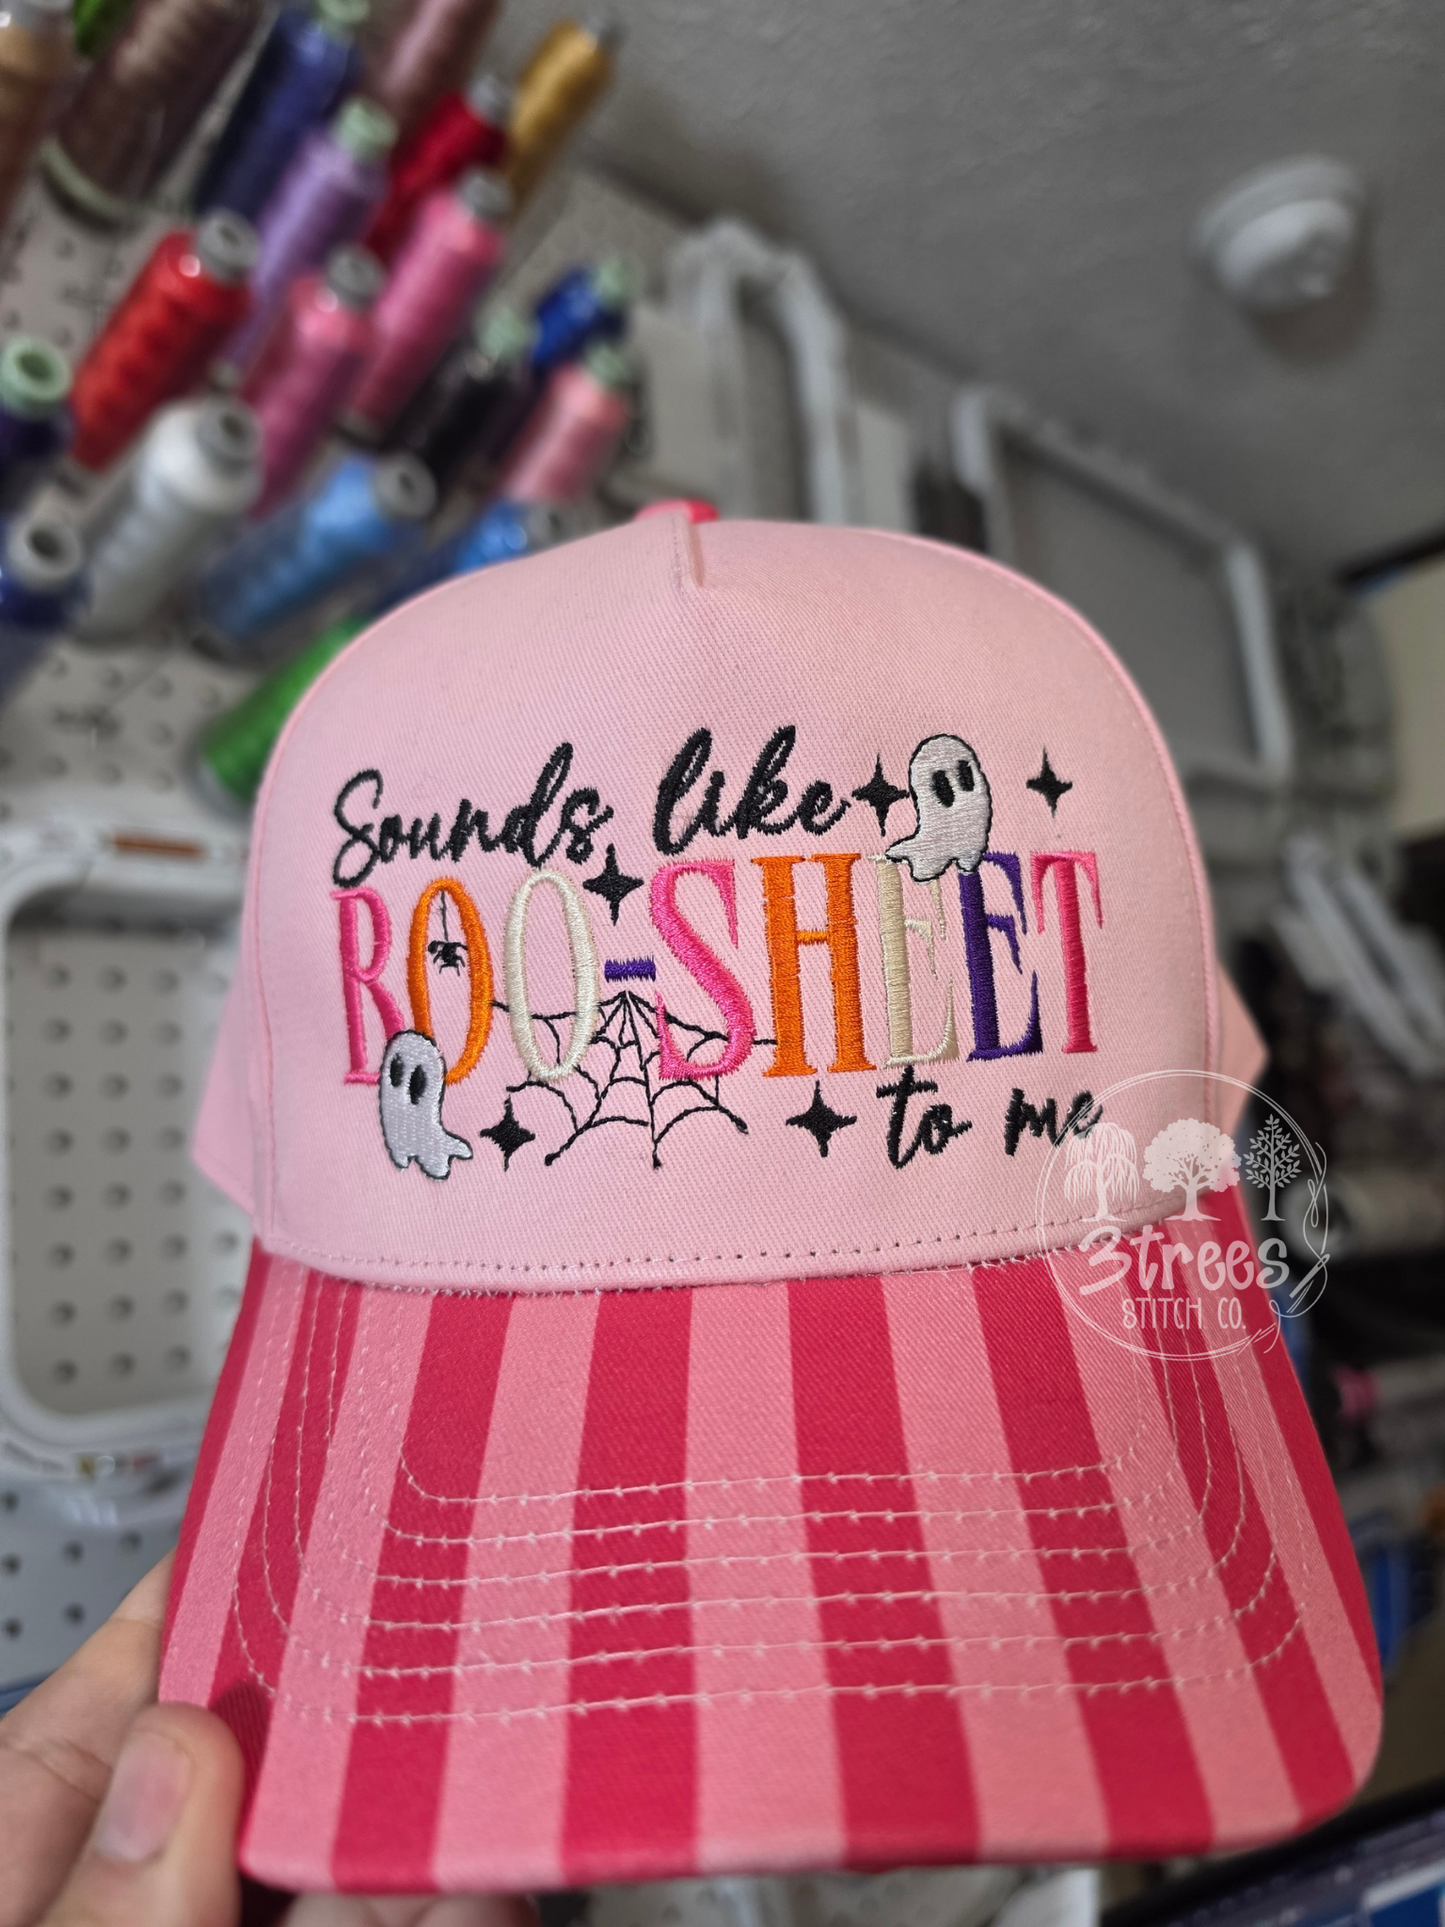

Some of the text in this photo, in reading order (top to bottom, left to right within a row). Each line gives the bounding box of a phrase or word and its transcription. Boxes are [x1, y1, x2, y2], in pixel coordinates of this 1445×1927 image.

[332, 725, 852, 888] Sounds like
[876, 1065, 1104, 1170] to me
